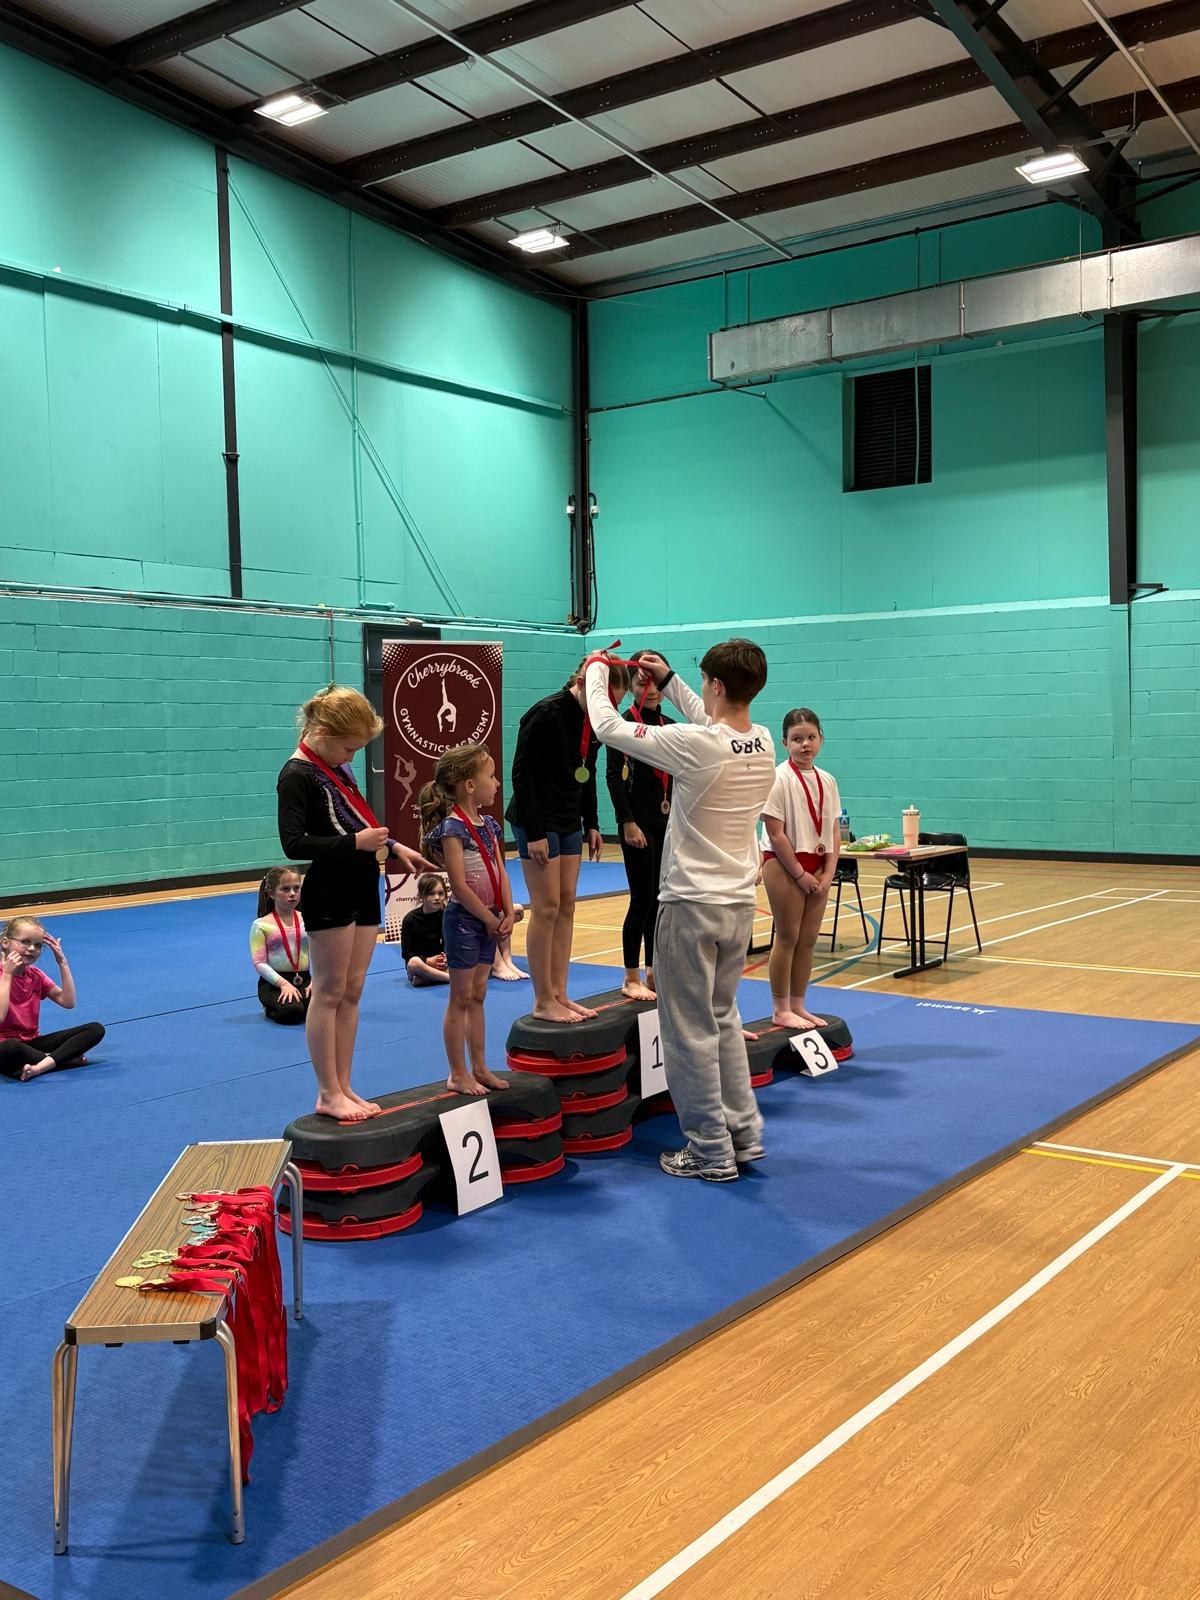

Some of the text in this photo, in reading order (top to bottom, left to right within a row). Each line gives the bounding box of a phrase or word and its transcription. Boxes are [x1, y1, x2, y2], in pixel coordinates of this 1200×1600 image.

[407, 658, 483, 689] Cherrybrook
[400, 708, 450, 753] GYMNASTICS
[731, 737, 766, 754] GBR
[652, 1035, 663, 1069] 1
[803, 1037, 829, 1070] 3
[462, 1130, 489, 1184] 2
